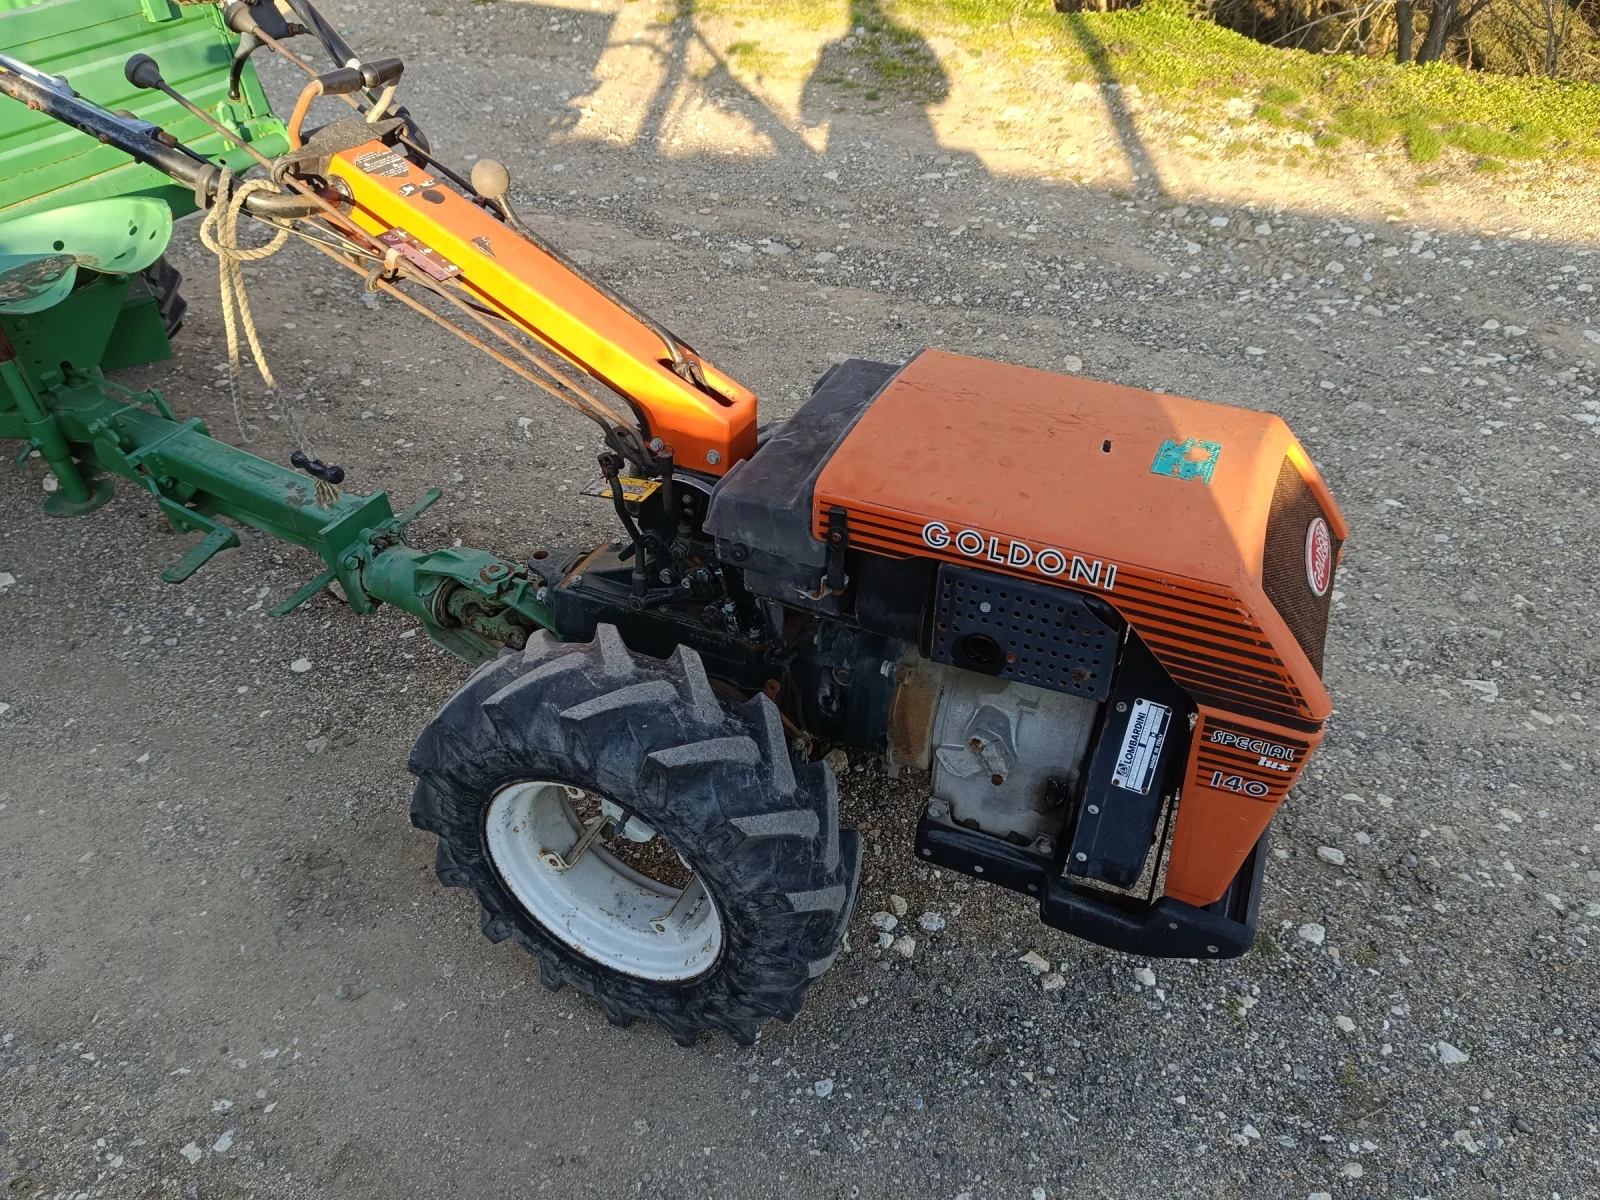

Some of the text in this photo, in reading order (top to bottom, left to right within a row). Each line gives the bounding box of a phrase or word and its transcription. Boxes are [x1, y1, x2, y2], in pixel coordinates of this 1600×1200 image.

[922, 521, 1117, 590] GOLDONI
[1124, 712, 1146, 764] LOMBARDINI
[1211, 730, 1294, 761] SPECIAL
[1149, 753, 1158, 768] MADE
[1258, 756, 1290, 771] lux
[1210, 771, 1268, 797] 140
